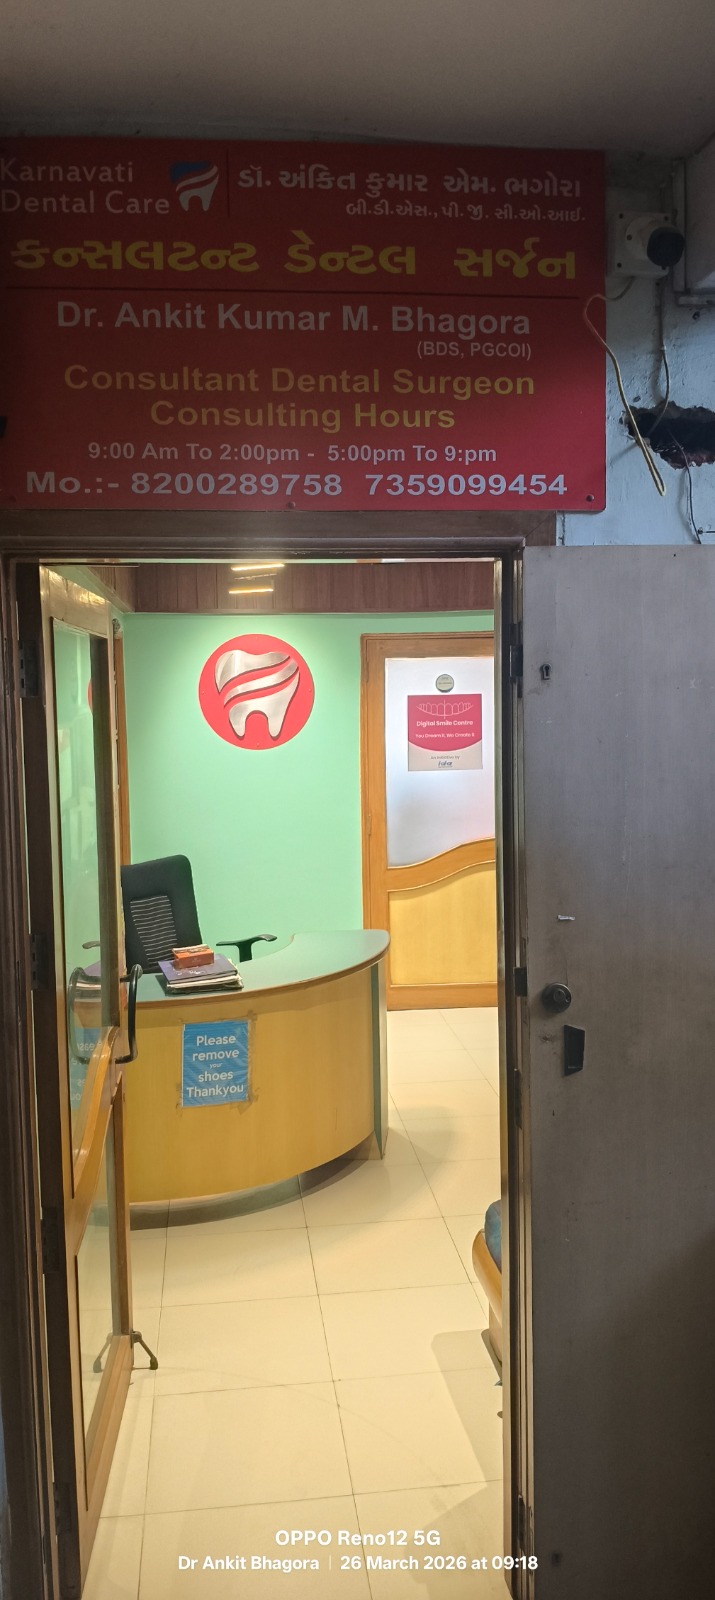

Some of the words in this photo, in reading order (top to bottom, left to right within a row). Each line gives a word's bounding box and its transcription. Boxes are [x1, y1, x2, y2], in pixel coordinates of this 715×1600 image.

[0, 158, 133, 183] Karnavati
[279, 164, 355, 189] અંકિત
[366, 173, 427, 198] કુમાર
[443, 168, 496, 194] એમ.
[505, 171, 580, 197] ભગોરા
[1, 190, 94, 214] Dental
[106, 190, 169, 214] Care
[10, 239, 260, 272] કન્સલટન્ટ
[284, 230, 415, 274] ડેન્ટલ
[454, 238, 575, 279] સર્જન
[58, 301, 103, 327] Dr.
[115, 303, 205, 328] Ankit
[219, 304, 330, 330] Kumar
[343, 306, 378, 331] M.
[392, 306, 529, 340] Bhagora
[418, 341, 464, 359] (BDS,
[471, 343, 531, 360] PGCOI)
[65, 365, 259, 392] Consultant
[272, 368, 379, 392] Dental
[393, 369, 534, 400] Surgeon
[152, 401, 340, 433] Consulting
[355, 404, 455, 428] Hours
[89, 442, 134, 459] 9:00
[142, 443, 178, 459] Am
[186, 444, 212, 460] To
[220, 444, 299, 464] 2:00pm
[328, 445, 405, 465] 5:00pm
[413, 445, 437, 461] To
[445, 446, 496, 465] 9:pm
[27, 472, 119, 493] Mo.:-
[132, 473, 342, 495] 8200289758
[366, 474, 567, 495] 7359099454
[196, 1035, 236, 1046] Please
[192, 1049, 239, 1061] remove
[198, 1071, 233, 1082] shoes
[186, 1084, 244, 1097] Thankyou
